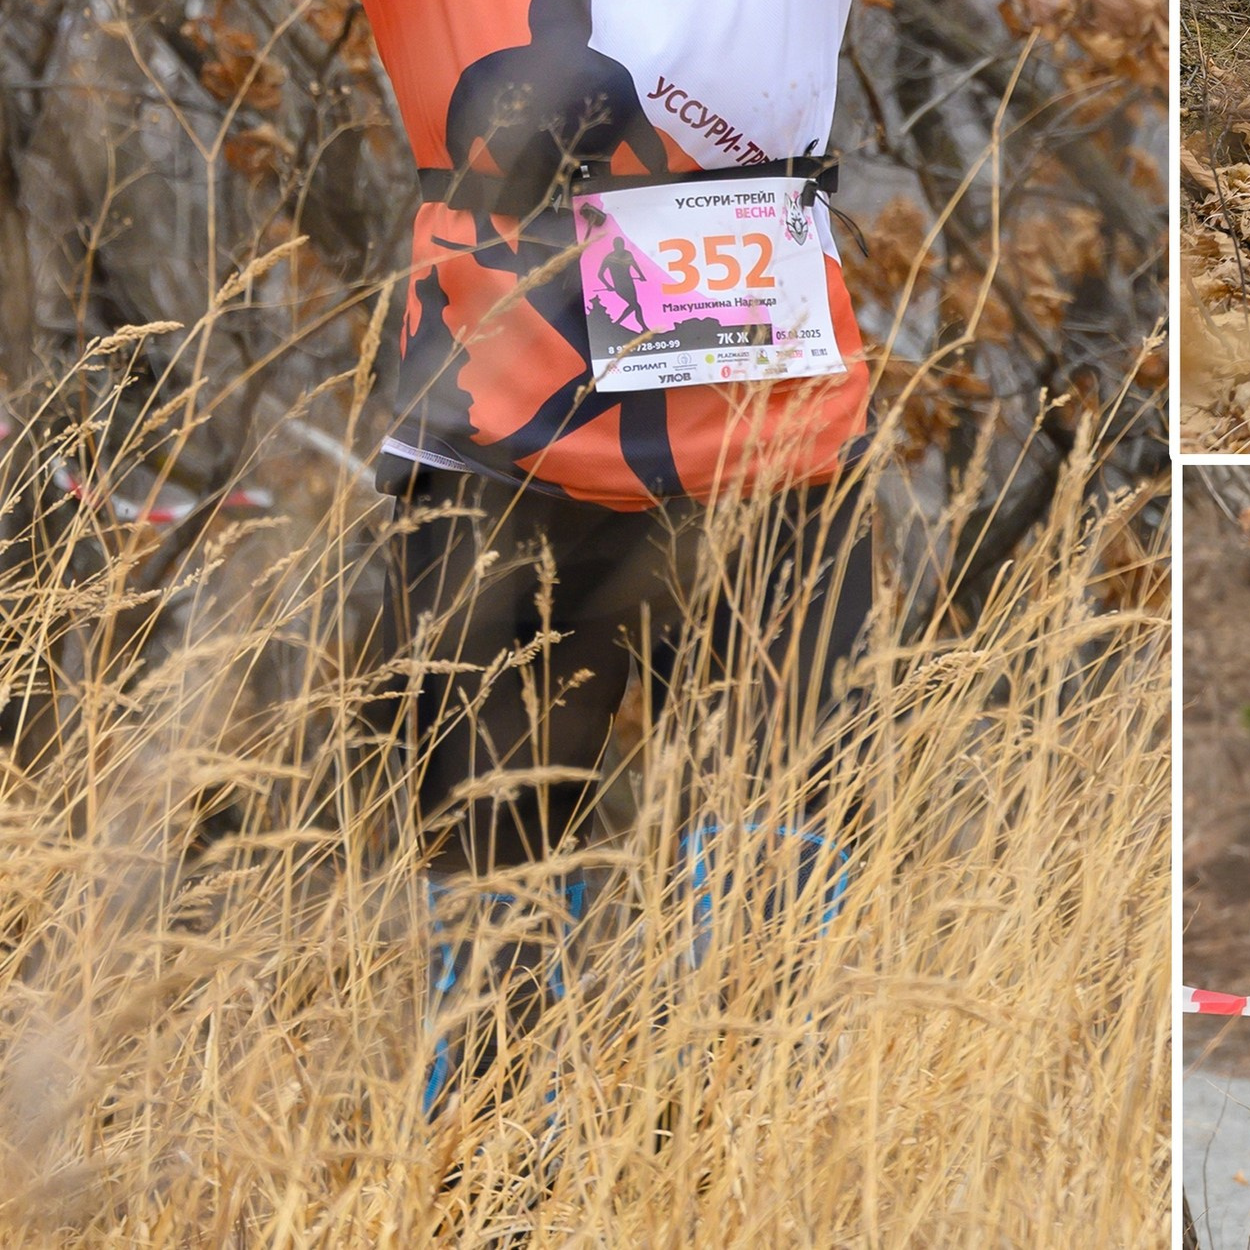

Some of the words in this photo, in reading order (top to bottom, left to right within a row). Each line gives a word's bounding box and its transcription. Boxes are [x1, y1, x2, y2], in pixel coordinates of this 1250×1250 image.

[675, 190, 776, 209] УССУРИ-ТРЕЙЛ
[735, 206, 776, 220] ВЕСНА
[658, 232, 776, 296] 352
[662, 299, 732, 313] Макушкина
[716, 333, 734, 345] 7К
[736, 331, 750, 344] Ж
[622, 361, 667, 372] ОЛИМП
[658, 372, 691, 384] УЛОВ
